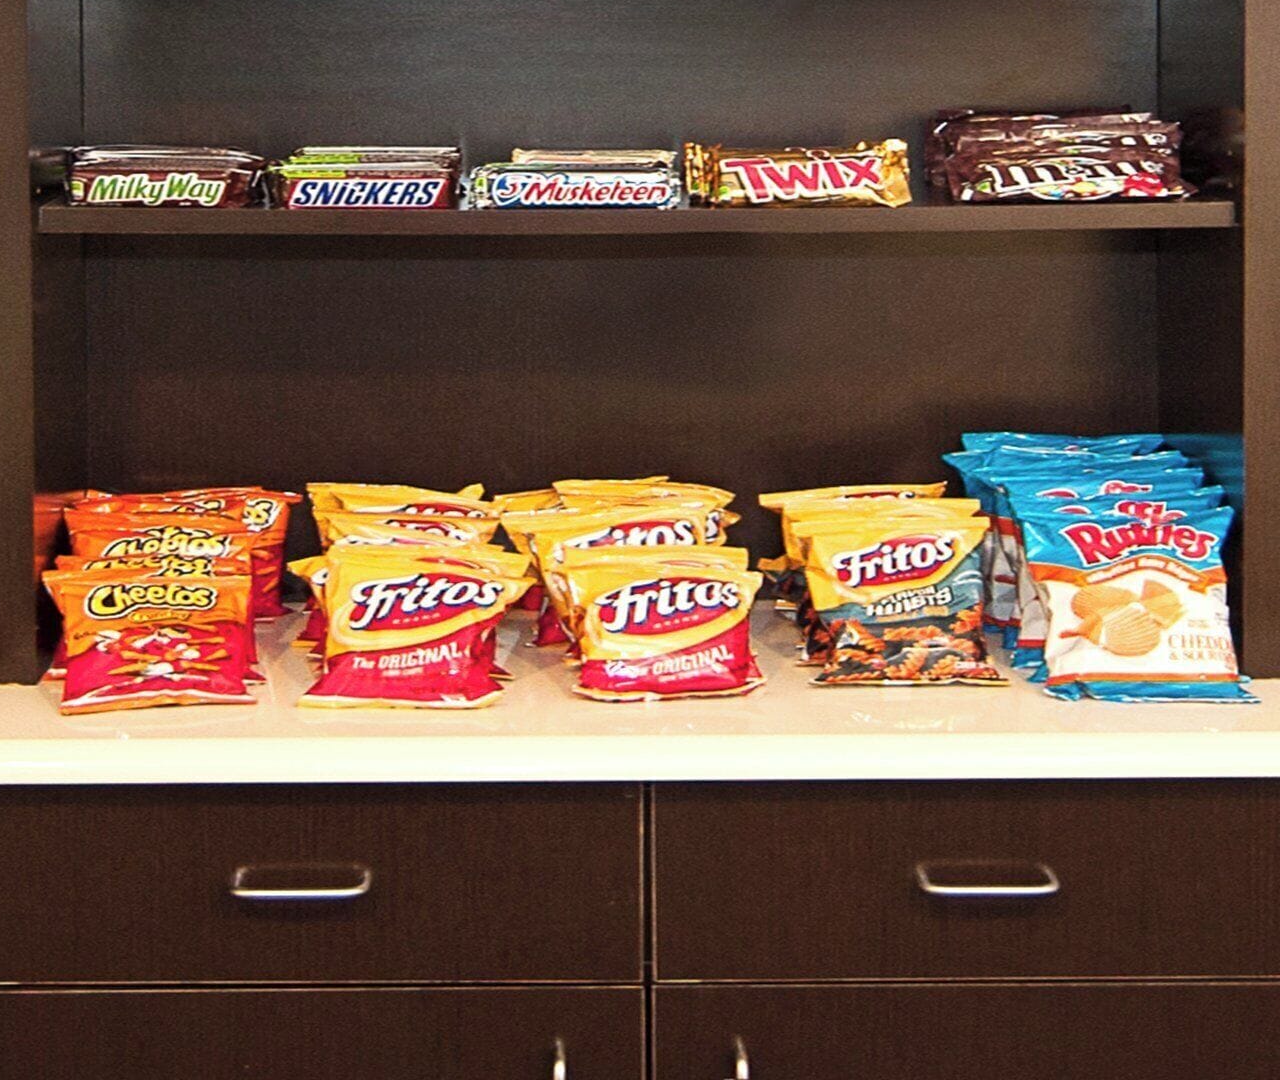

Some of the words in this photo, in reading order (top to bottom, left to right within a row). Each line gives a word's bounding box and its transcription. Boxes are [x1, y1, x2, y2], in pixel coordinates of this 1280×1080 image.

[293, 181, 441, 206] SNICKERS
[499, 182, 520, 200] 3
[833, 531, 956, 584] Fritos
[86, 584, 218, 618] Cheetos
[350, 576, 504, 630] Fritos
[596, 579, 740, 633] Fritos
[352, 656, 375, 669] The
[378, 644, 463, 669] ORIGINAL
[652, 646, 734, 675] ORIGINAL
